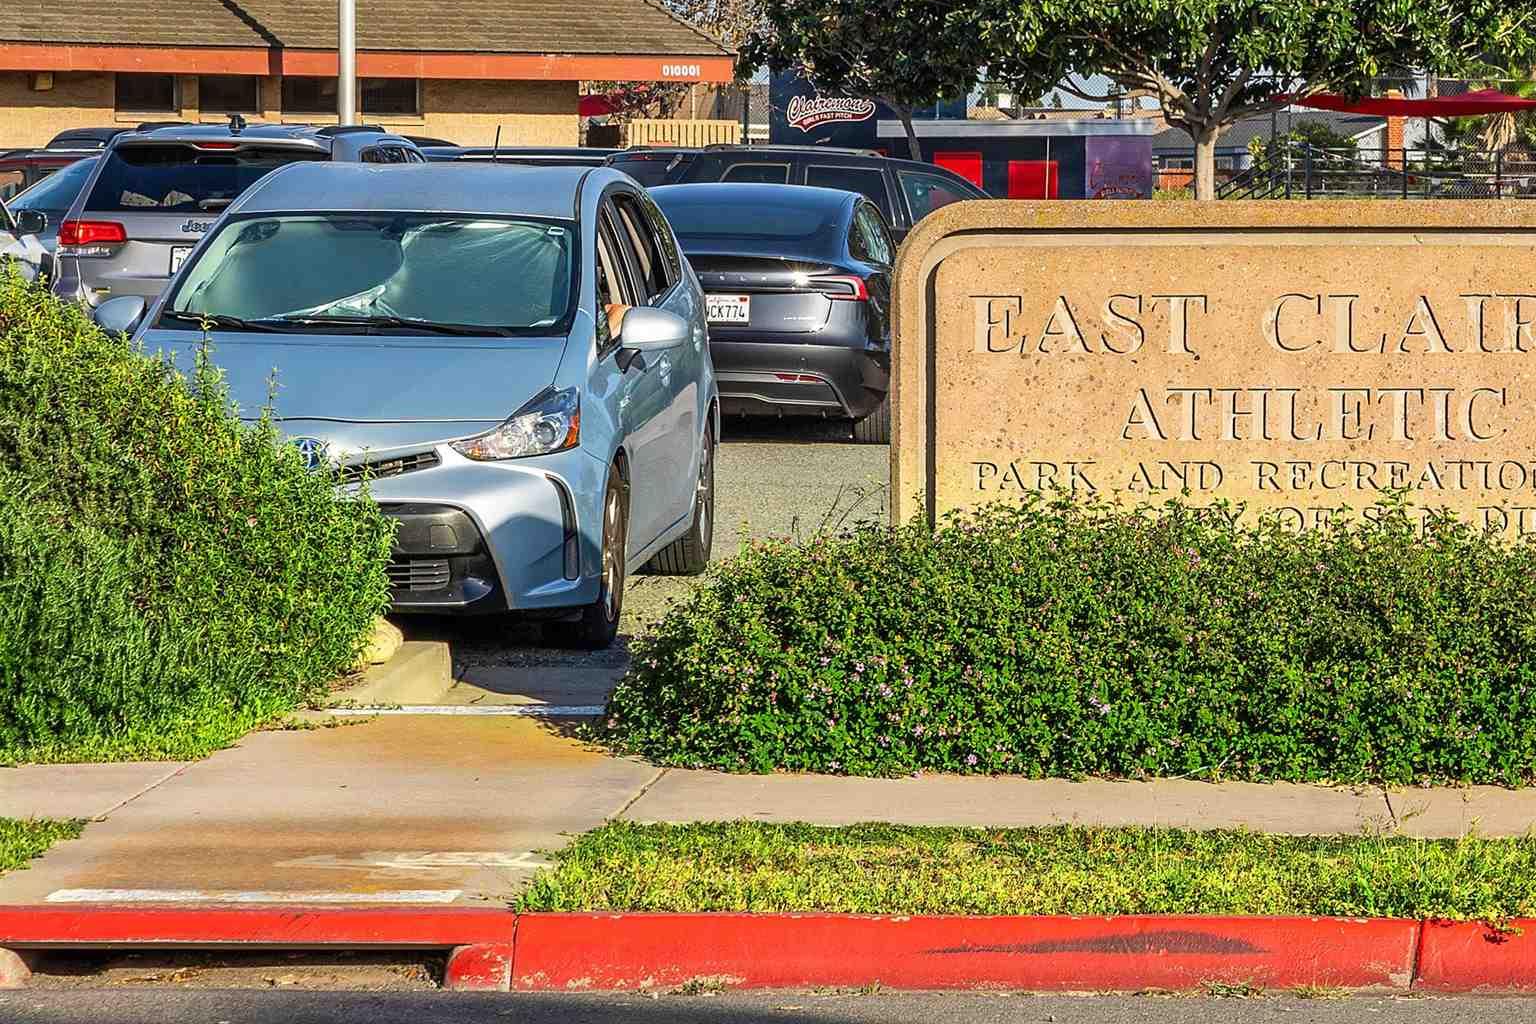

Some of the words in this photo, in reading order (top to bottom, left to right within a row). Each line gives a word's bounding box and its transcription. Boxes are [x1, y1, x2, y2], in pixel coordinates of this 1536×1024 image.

[662, 64, 701, 76] 010001
[968, 294, 1208, 355] EAST
[1120, 387, 1507, 443] ATHLETIC
[970, 460, 1098, 492] PARK
[1127, 460, 1224, 491] AND
